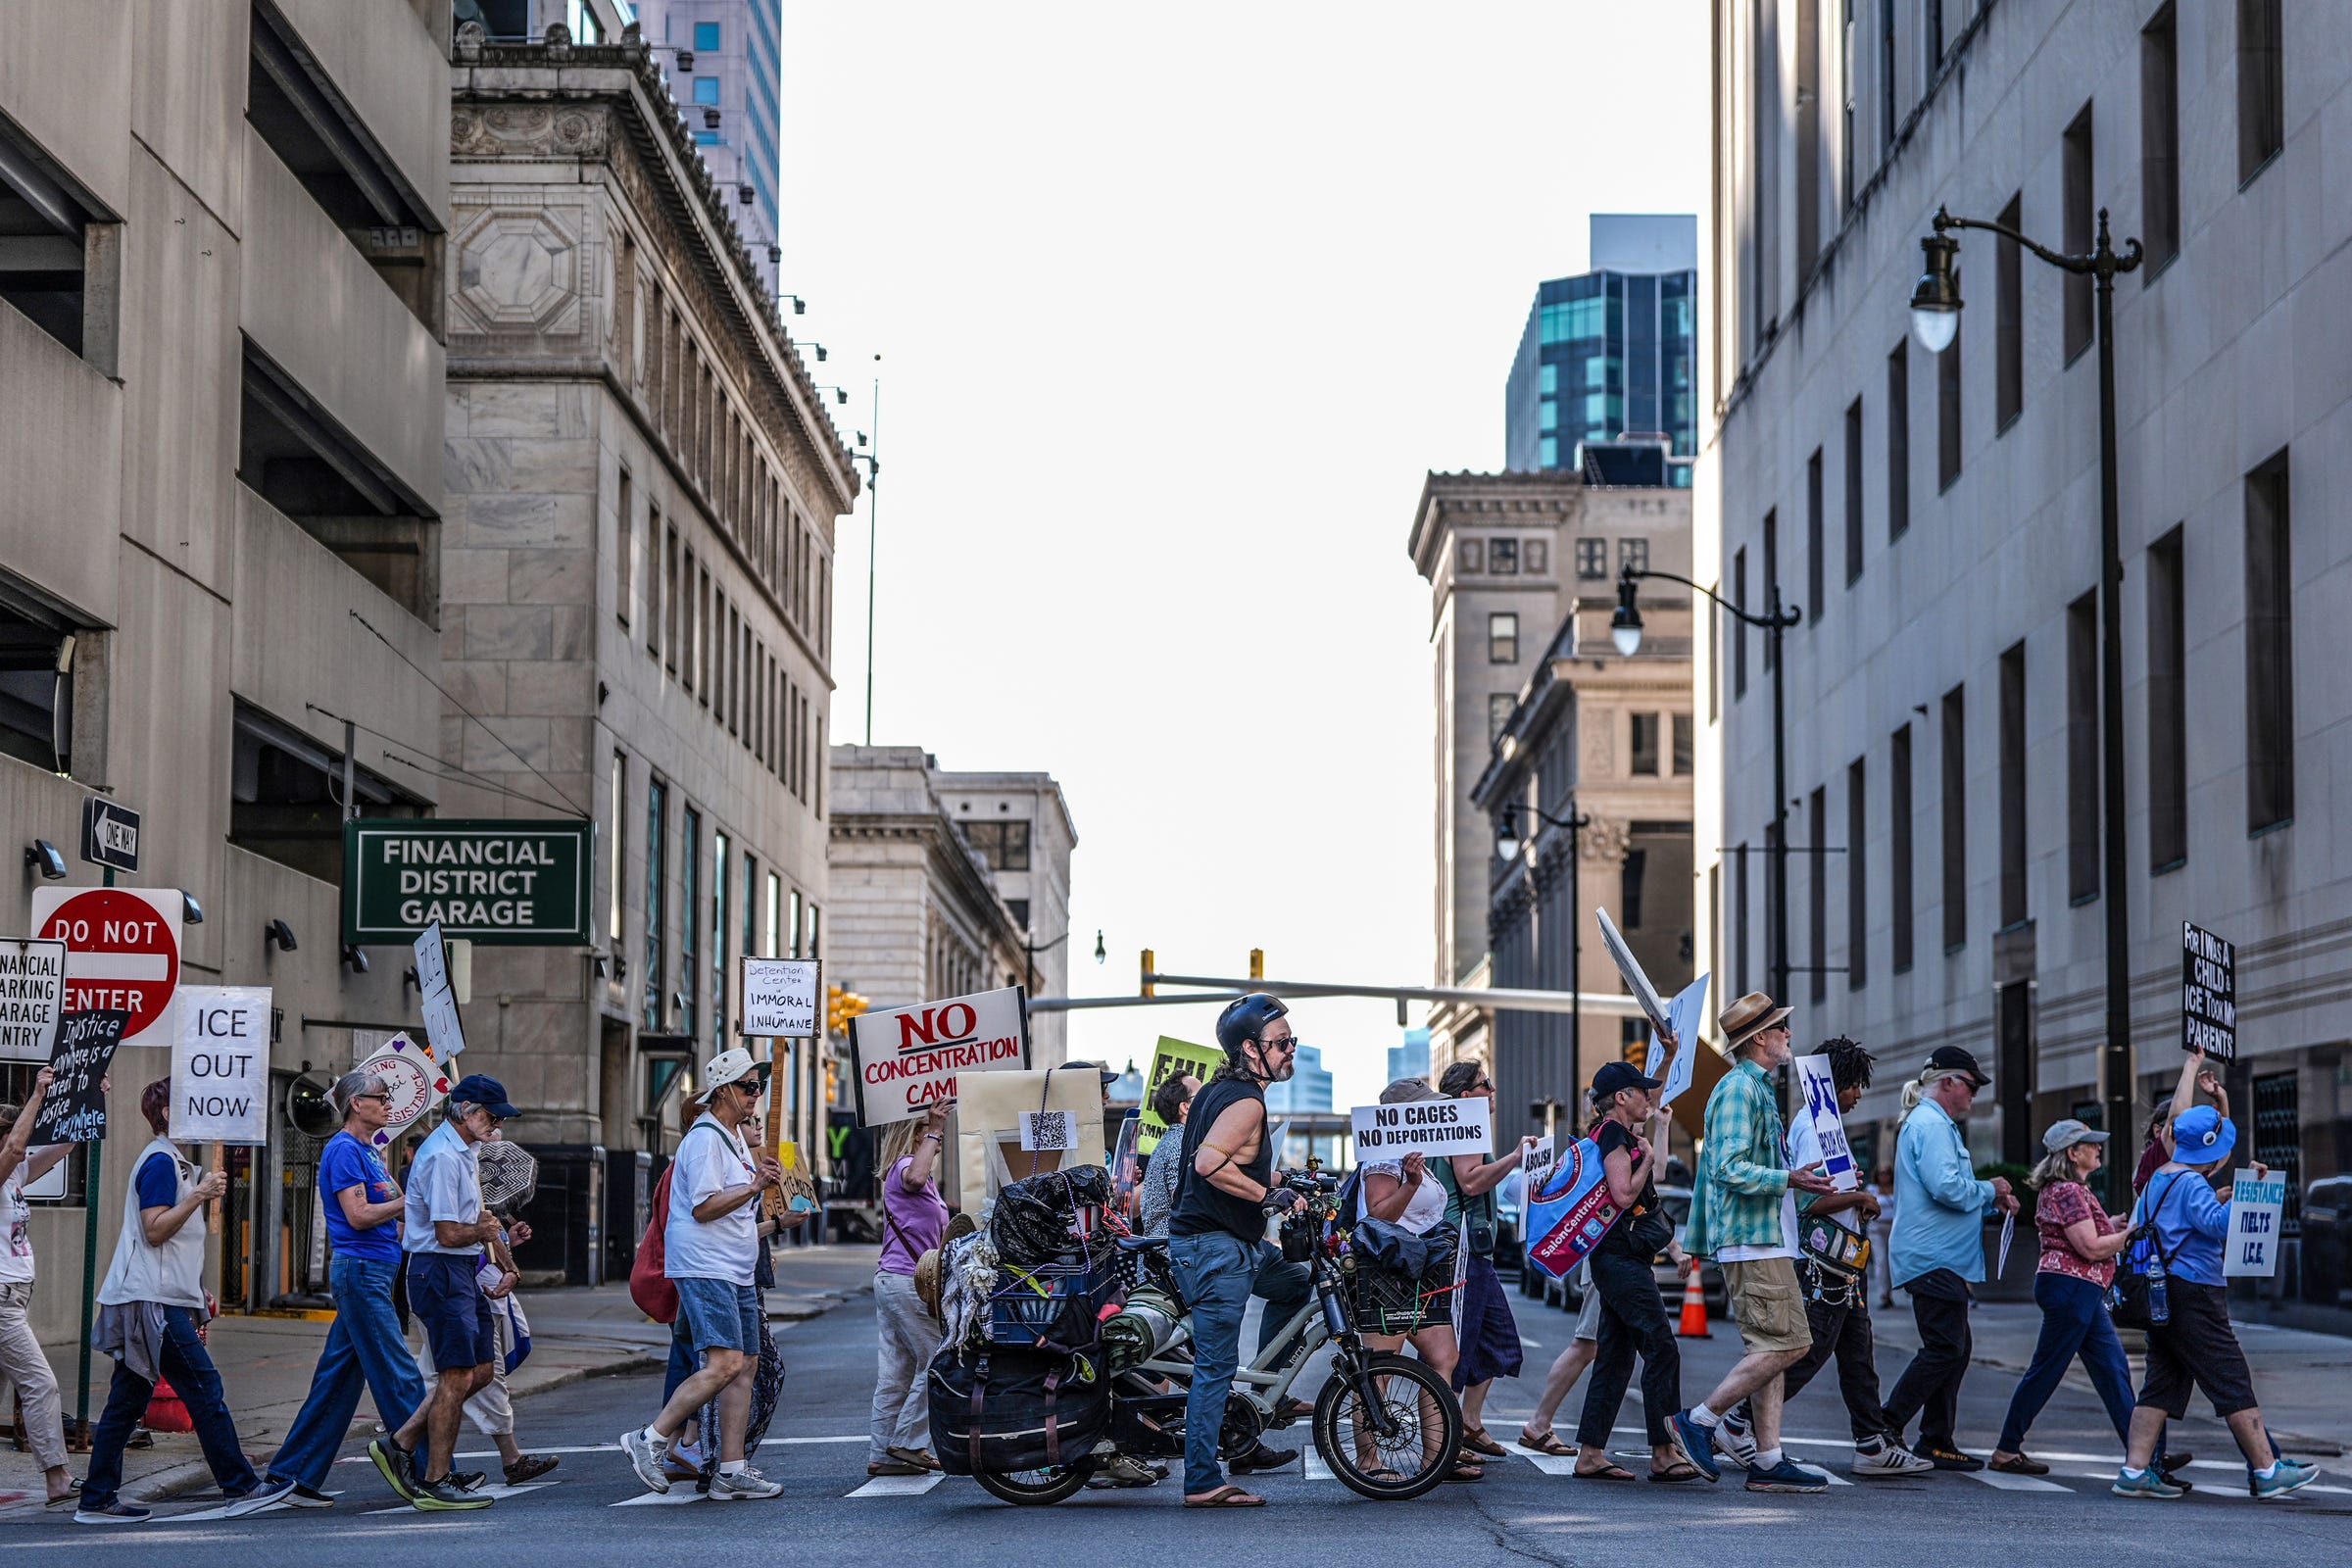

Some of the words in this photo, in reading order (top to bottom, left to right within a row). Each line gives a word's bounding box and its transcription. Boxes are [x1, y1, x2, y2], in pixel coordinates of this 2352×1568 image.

[106, 822, 120, 848] ONE
[121, 827, 135, 854] WAY
[383, 840, 555, 865] FINANCIAL
[400, 869, 537, 895] DISTRICT
[399, 900, 534, 925] GARAGE
[55, 919, 89, 942] DO
[104, 920, 158, 944] NOT
[0, 955, 58, 976] NANCIAL
[2223, 942, 2230, 968] A
[2194, 956, 2225, 993] CHILD
[2226, 975, 2230, 992] &
[0, 979, 54, 1001] ARKING
[63, 988, 143, 1012] ENTER
[751, 993, 812, 1007] IMMORAL
[2184, 984, 2203, 1013] ICE
[0, 1002, 50, 1024] ARAGE
[198, 1008, 248, 1037] ICE
[751, 1014, 812, 1028] INHUMANE
[0, 1025, 42, 1047] NTRY
[63, 1013, 120, 1045] Injustice
[894, 1004, 978, 1050] NO
[2186, 1016, 2233, 1058] PARENTS
[90, 1041, 101, 1063] is
[102, 1045, 115, 1058] a
[865, 1036, 1018, 1085] CONCENTRATION
[190, 1054, 253, 1078] OUT
[77, 1068, 89, 1092] to
[385, 1074, 407, 1102] psi
[906, 1076, 957, 1104] CAM
[188, 1097, 250, 1117] NOW
[386, 1071, 426, 1122] ESISTANCE
[1375, 1108, 1398, 1127] NO
[1404, 1104, 1458, 1125] CAGES
[86, 1128, 100, 1139] JR
[1358, 1129, 1382, 1148] NO
[1387, 1124, 1482, 1145] DEPORTATIONS
[1525, 1148, 1552, 1174] ABOLISH
[2233, 1180, 2284, 1204] RESISTANCE
[2240, 1211, 2271, 1234] MELTS
